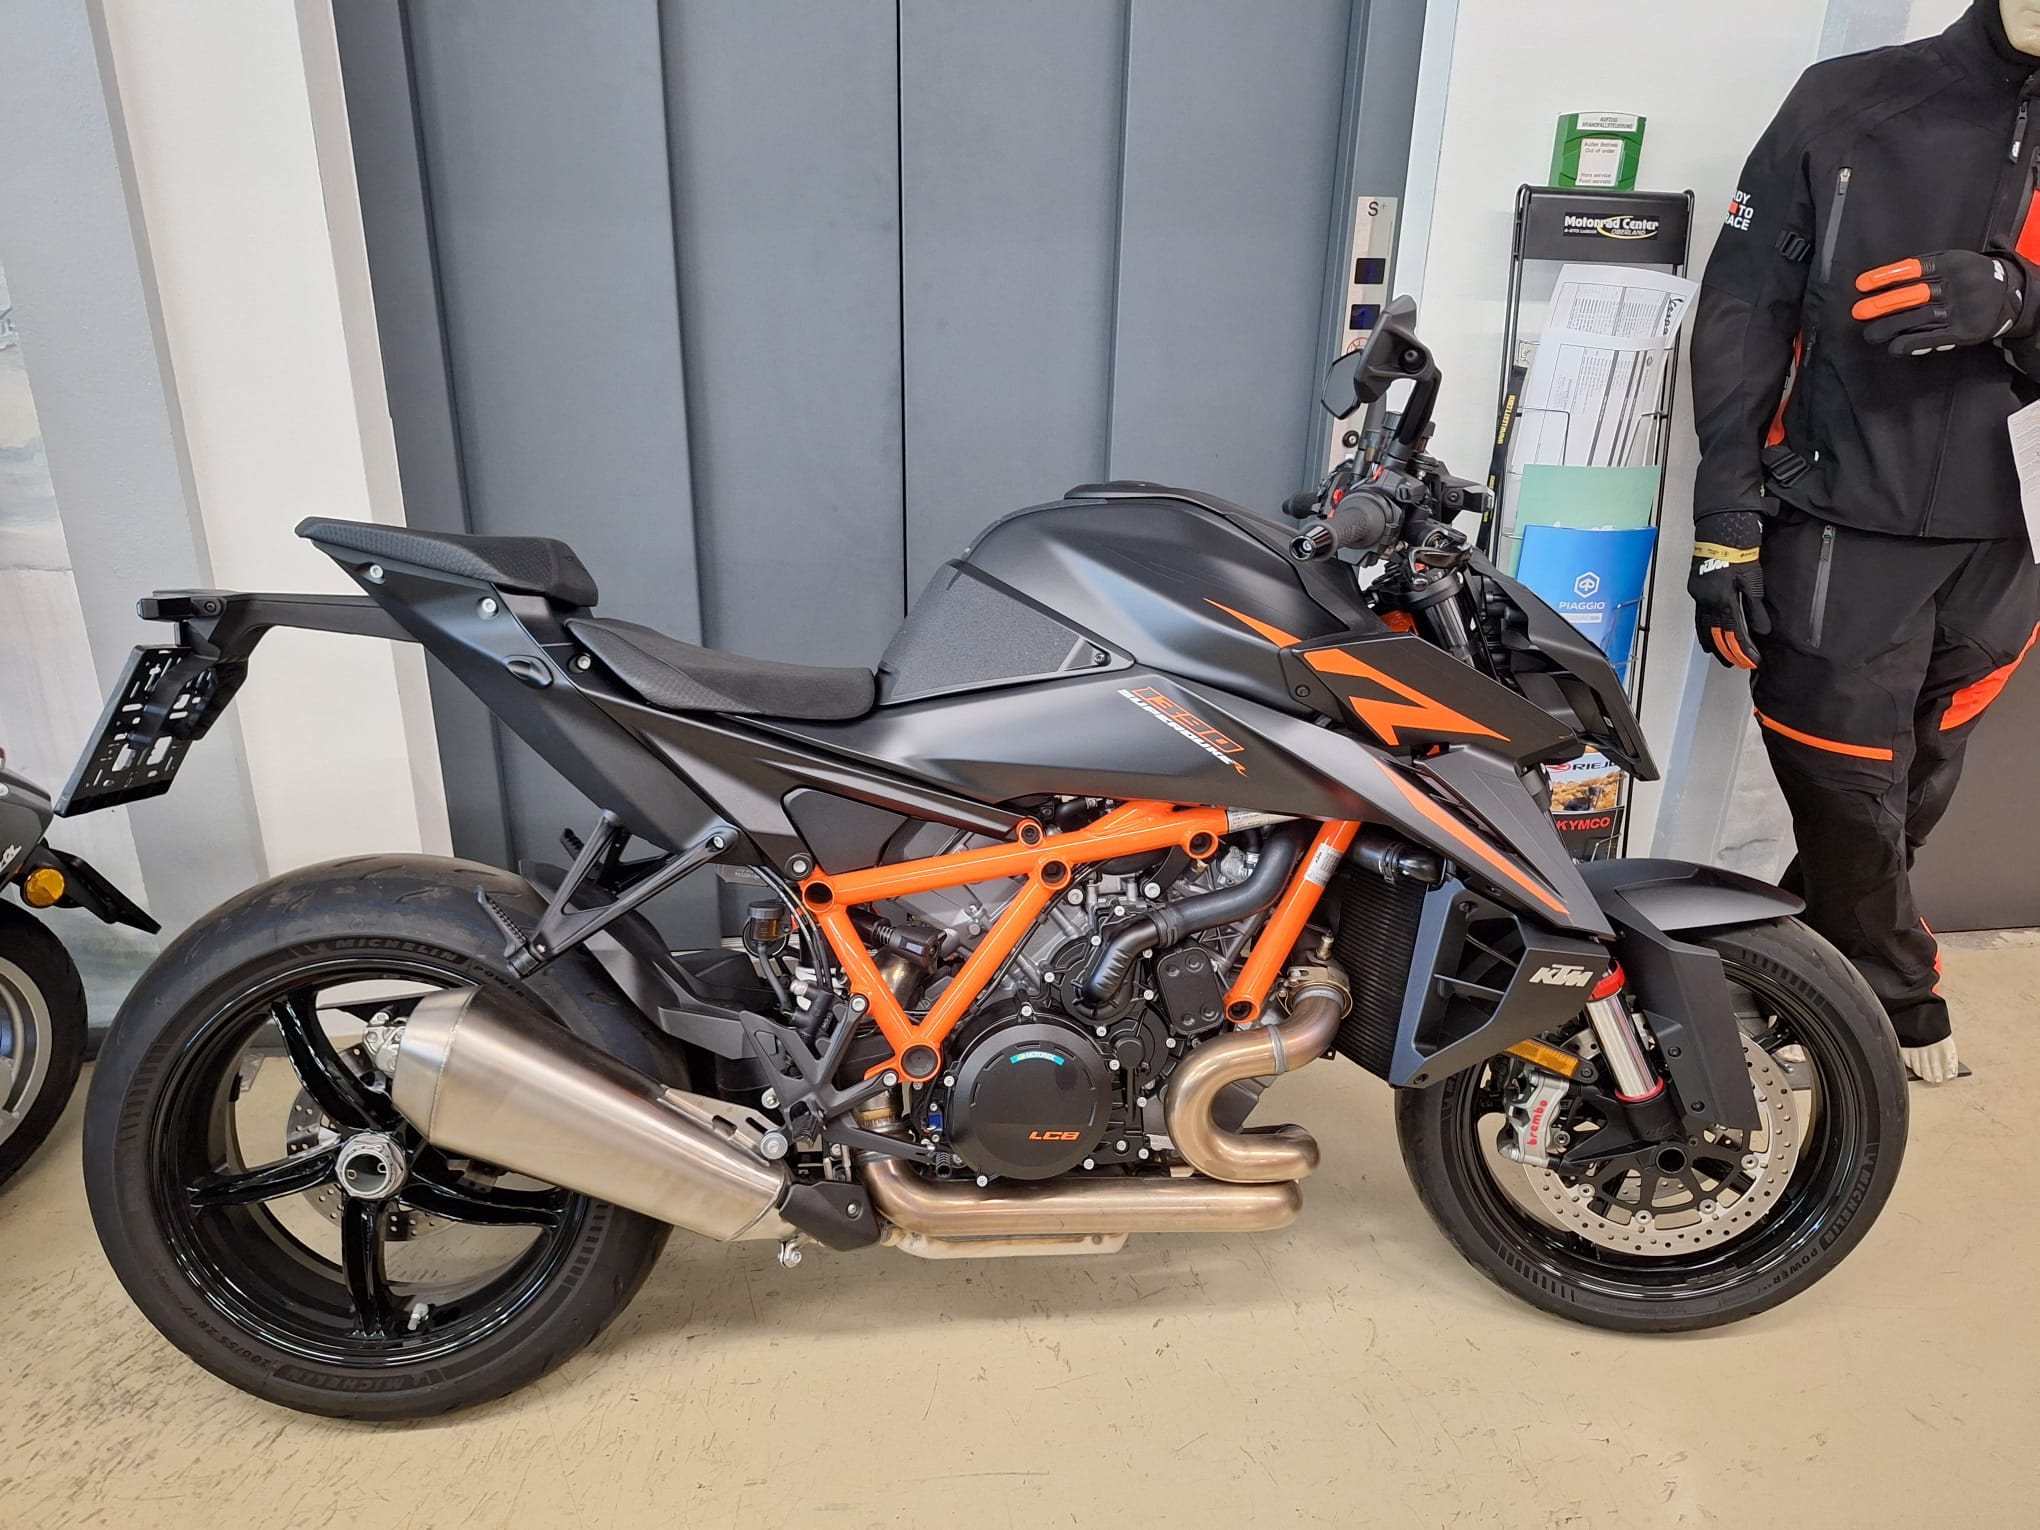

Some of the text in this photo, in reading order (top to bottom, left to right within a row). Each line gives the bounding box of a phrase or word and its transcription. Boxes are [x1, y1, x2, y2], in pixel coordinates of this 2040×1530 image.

[1368, 201, 1379, 216] S
[1738, 205, 1754, 219] TO
[1564, 215, 1659, 230] Motorrad Center
[1663, 297, 1684, 336] Vespa
[1559, 601, 1605, 610] PIAGGIO
[1556, 817, 1611, 831] KYMCO
[335, 938, 458, 962] MICHELIN
[1529, 963, 1594, 987] KTM
[1526, 1100, 1549, 1146] brembo
[1028, 1131, 1081, 1141] LC8
[1772, 1167, 1871, 1285] MICHELIN POWER
